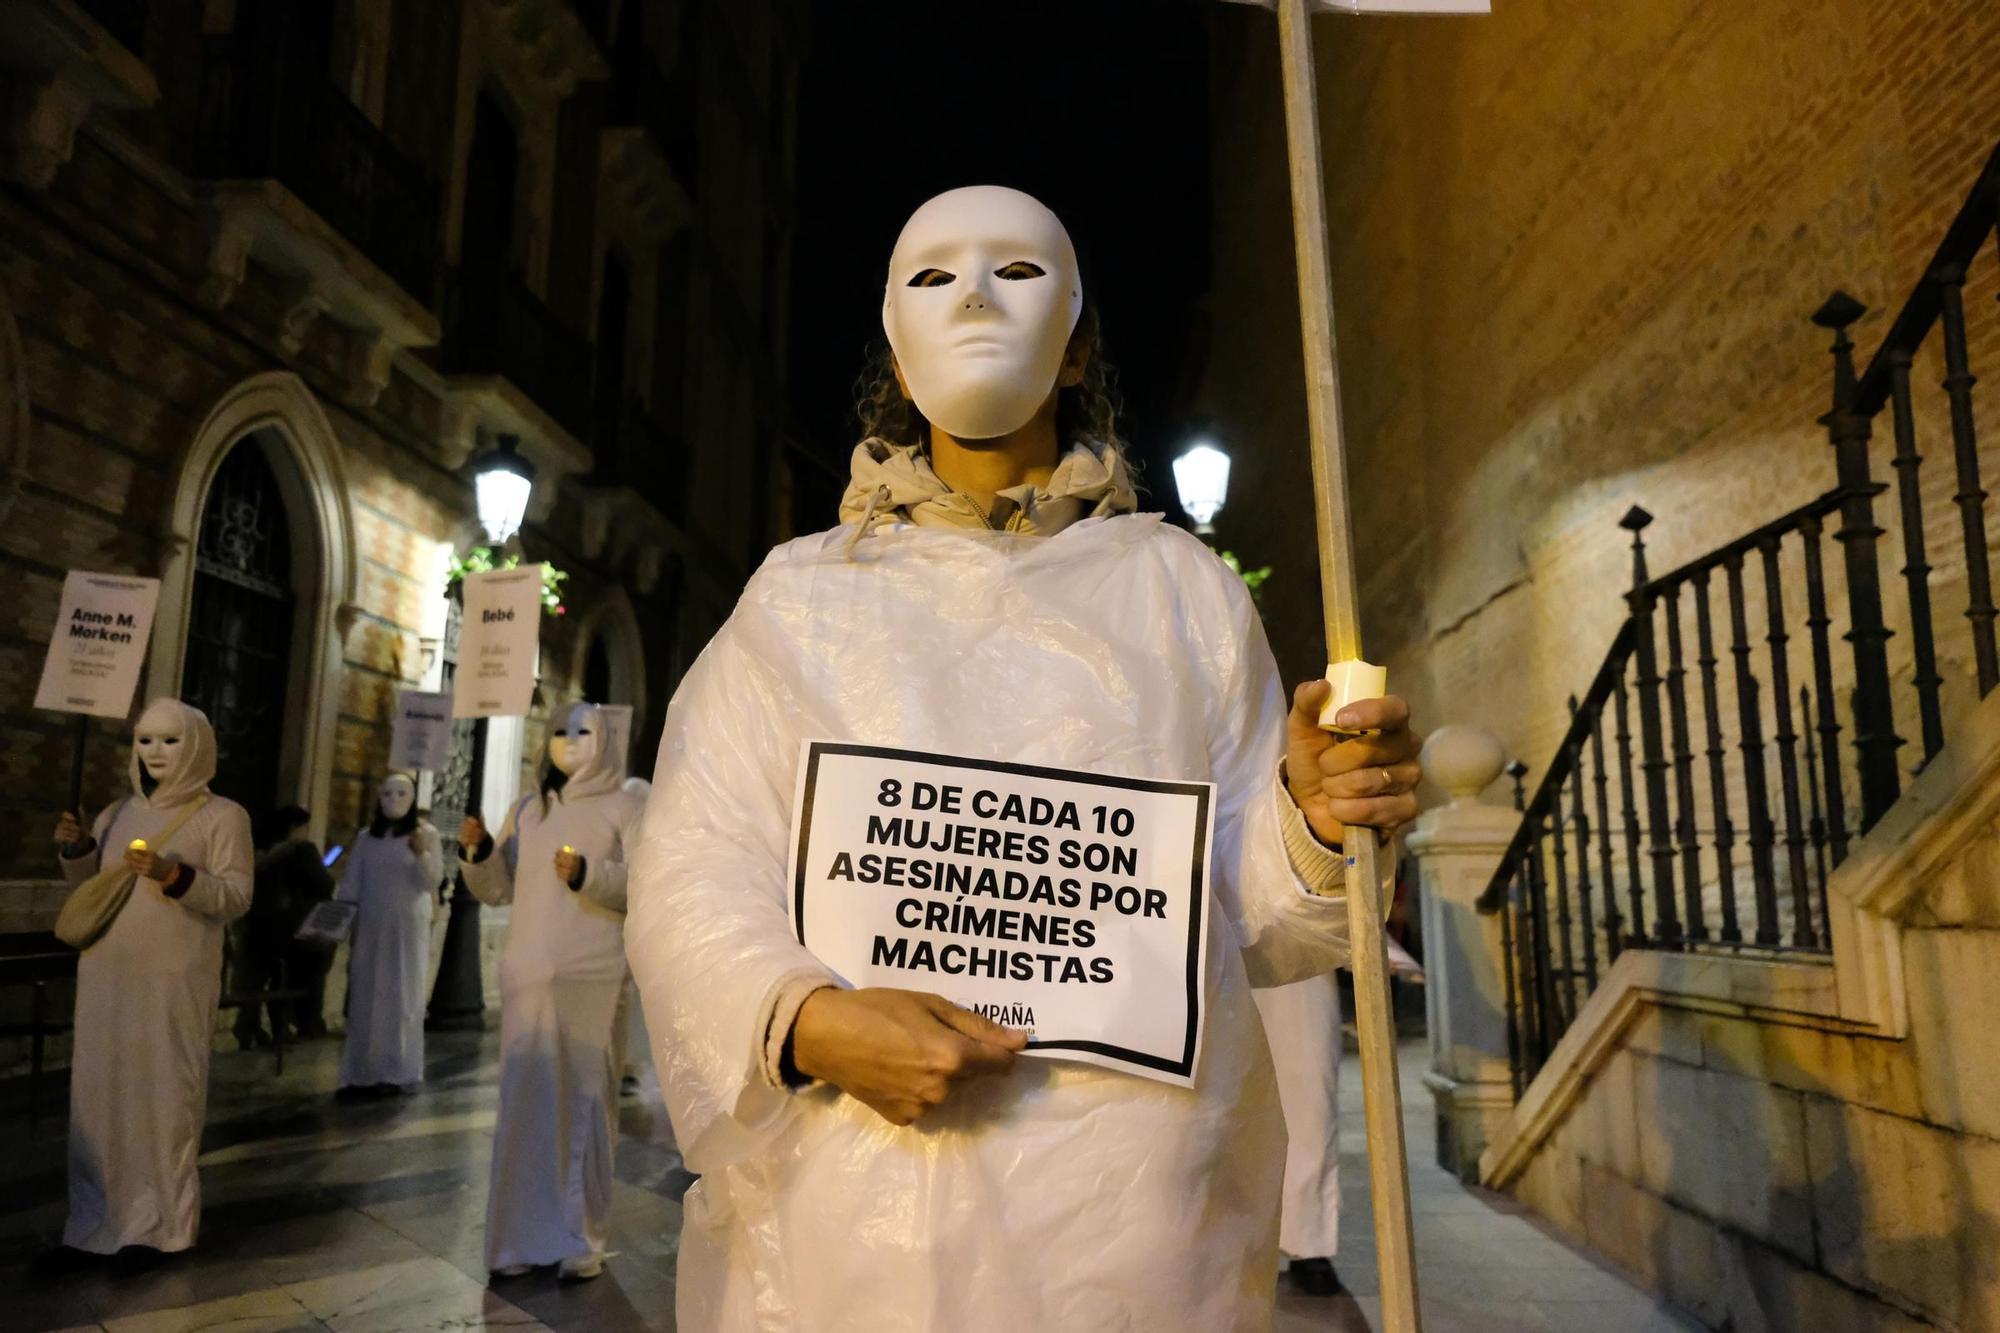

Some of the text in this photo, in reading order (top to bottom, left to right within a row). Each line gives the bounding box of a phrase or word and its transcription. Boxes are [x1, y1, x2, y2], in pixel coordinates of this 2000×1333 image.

[71, 608, 137, 629] Anne M.
[482, 606, 515, 624] Bebé
[877, 778, 1135, 838] 8 DE CADA 10
[866, 815, 1138, 877] MUJERES SON
[827, 852, 1168, 919] ASESINADAS POR
[895, 895, 1096, 948] CRÍMENES
[871, 935, 1114, 984] MACHISTAS
